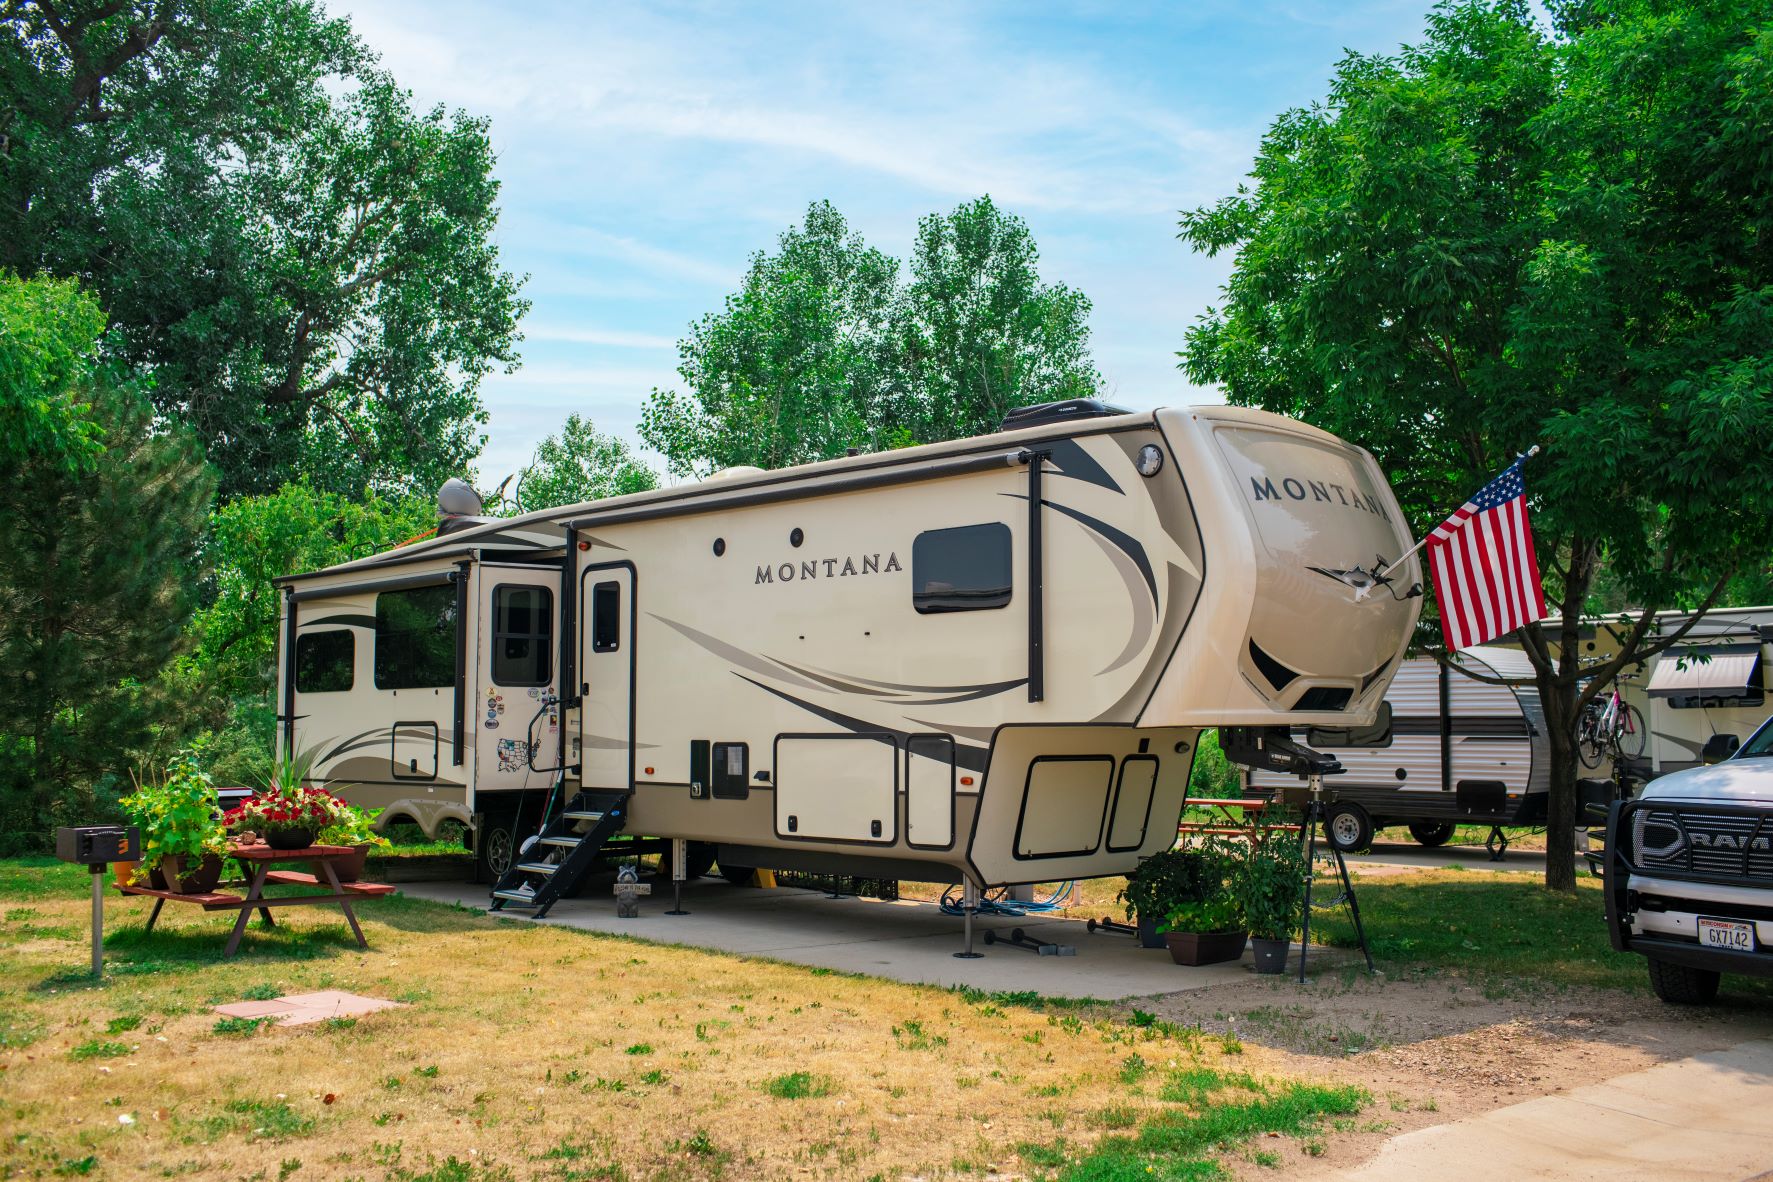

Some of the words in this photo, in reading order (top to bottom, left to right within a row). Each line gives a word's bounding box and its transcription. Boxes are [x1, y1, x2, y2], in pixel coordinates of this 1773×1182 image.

[1250, 476, 1392, 523] MONTANA
[755, 552, 902, 584] MONTANA
[1688, 832, 1770, 849] RAM
[1709, 928, 1749, 947] GX7142
